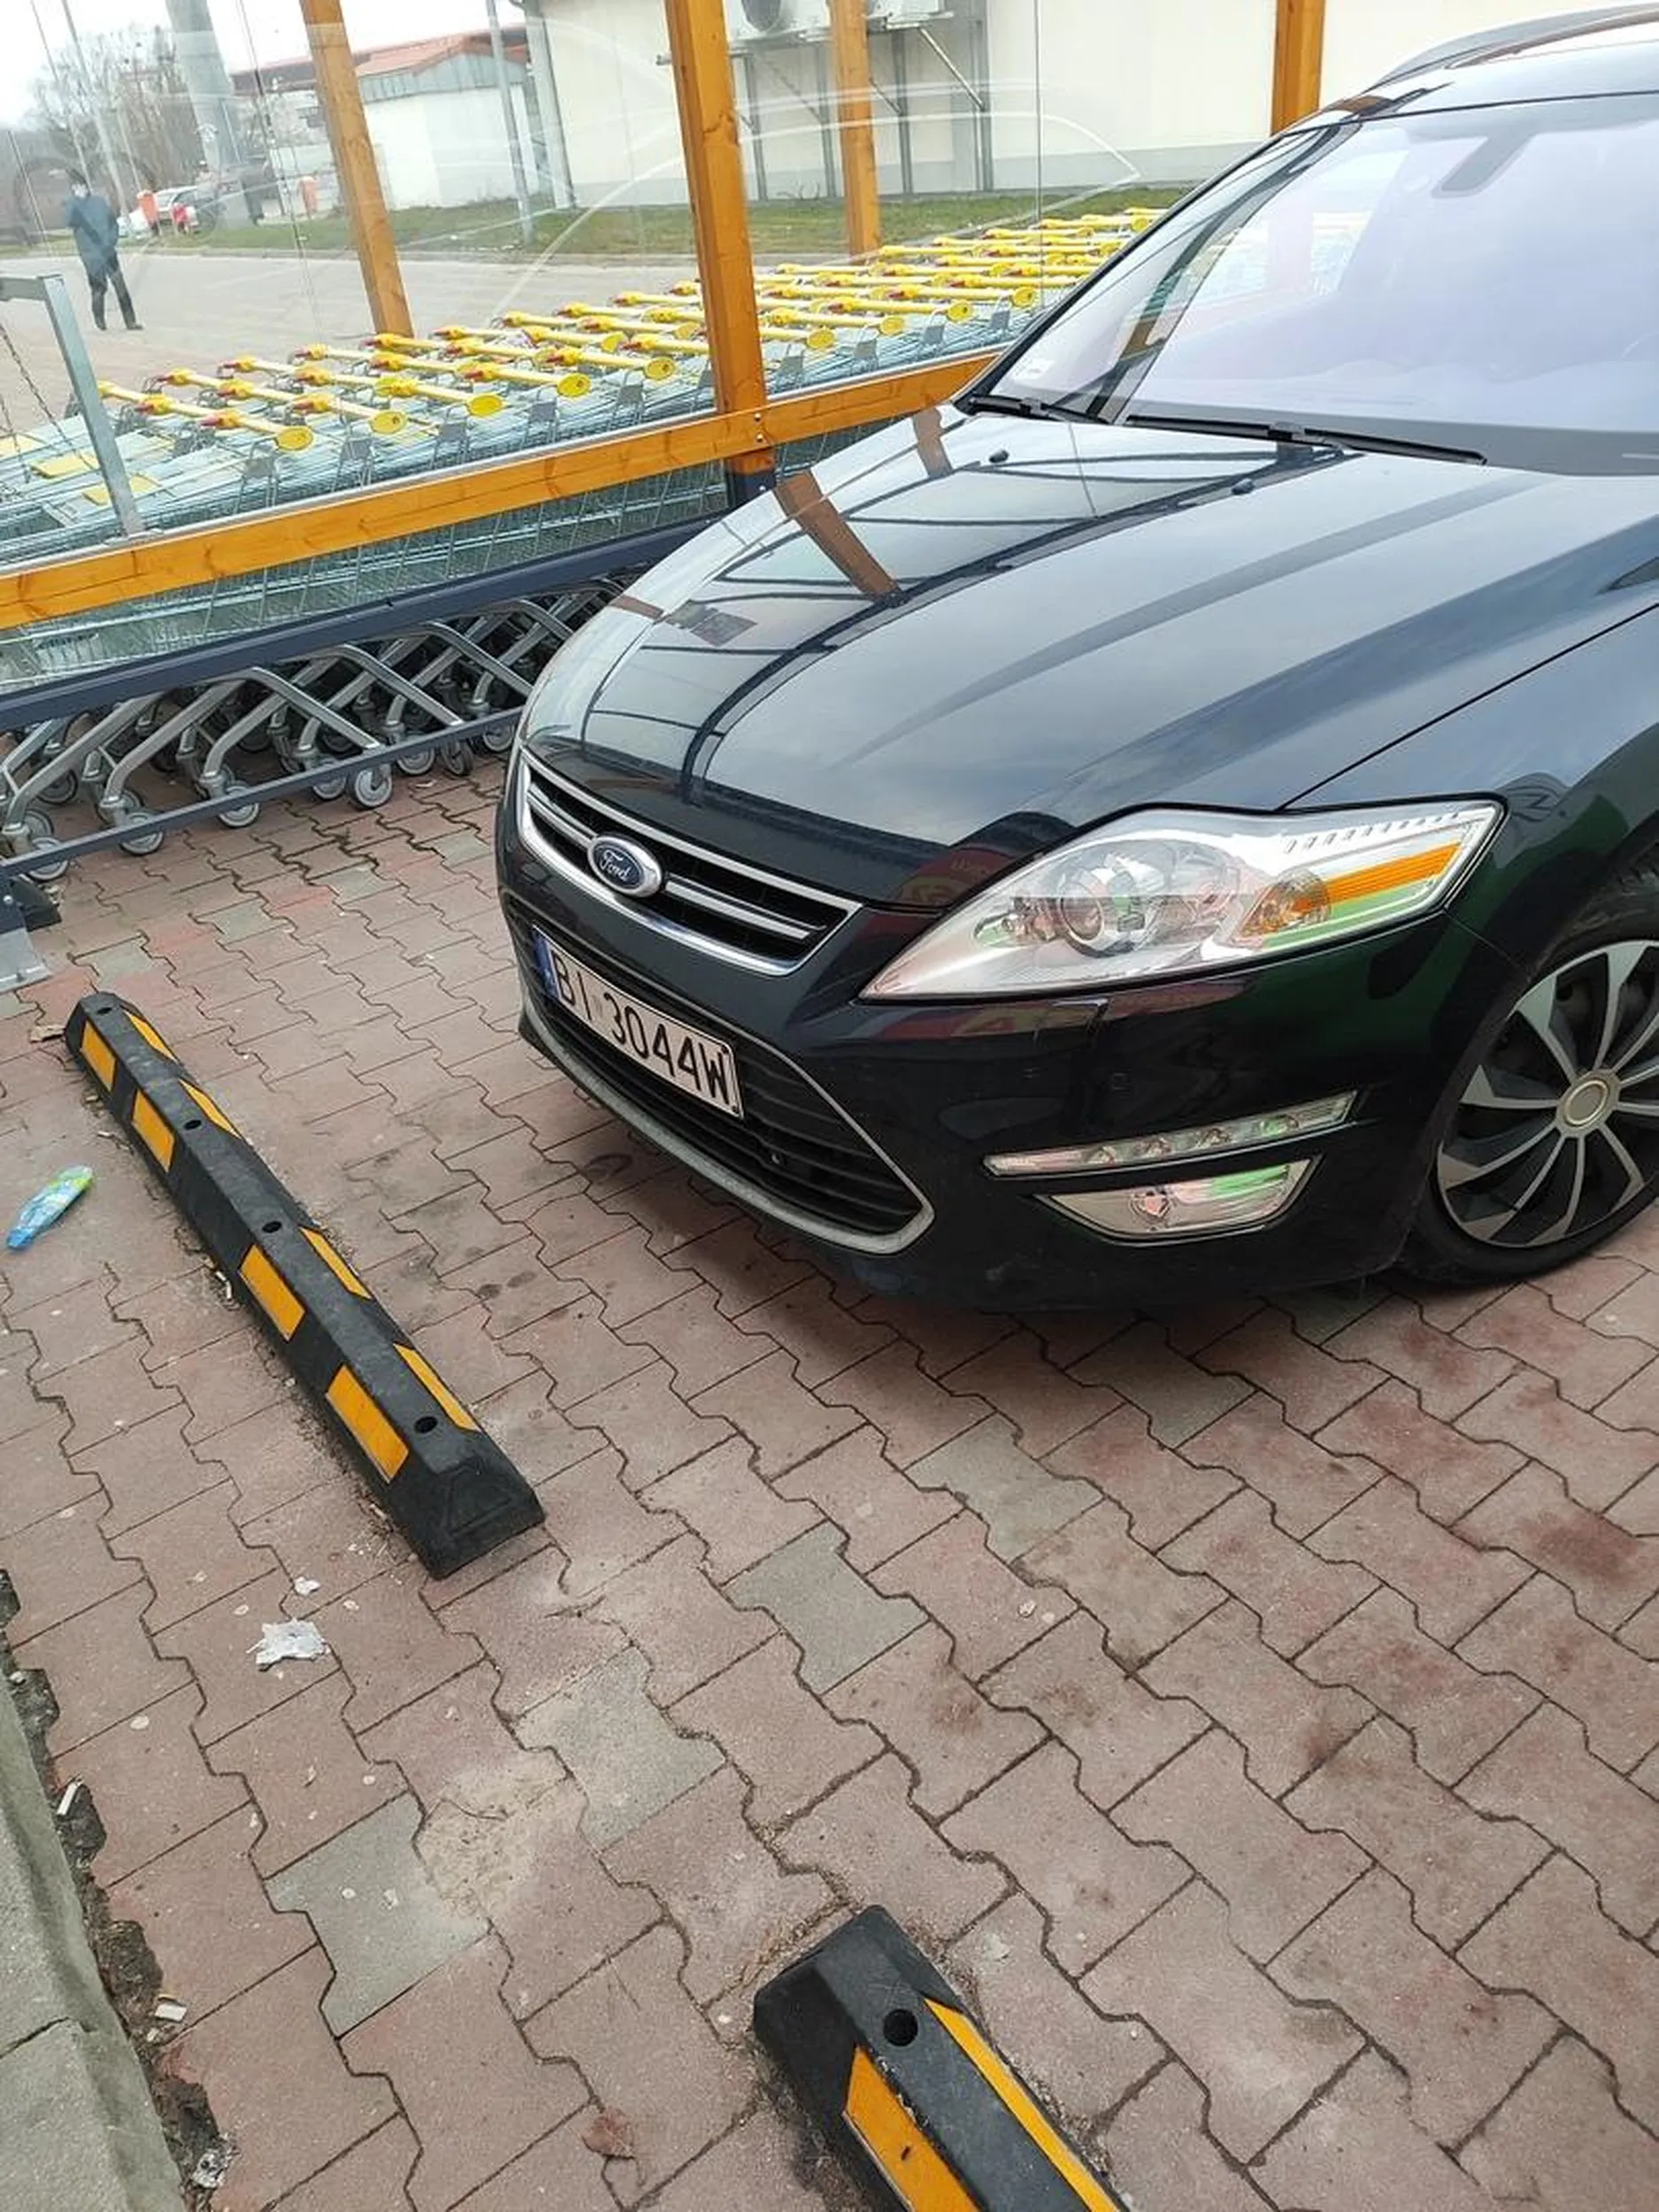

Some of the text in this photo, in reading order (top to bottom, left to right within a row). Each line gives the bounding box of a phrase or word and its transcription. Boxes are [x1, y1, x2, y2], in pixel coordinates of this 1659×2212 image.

[599, 849, 632, 881] Ford
[552, 949, 730, 1105] BI 3044W
